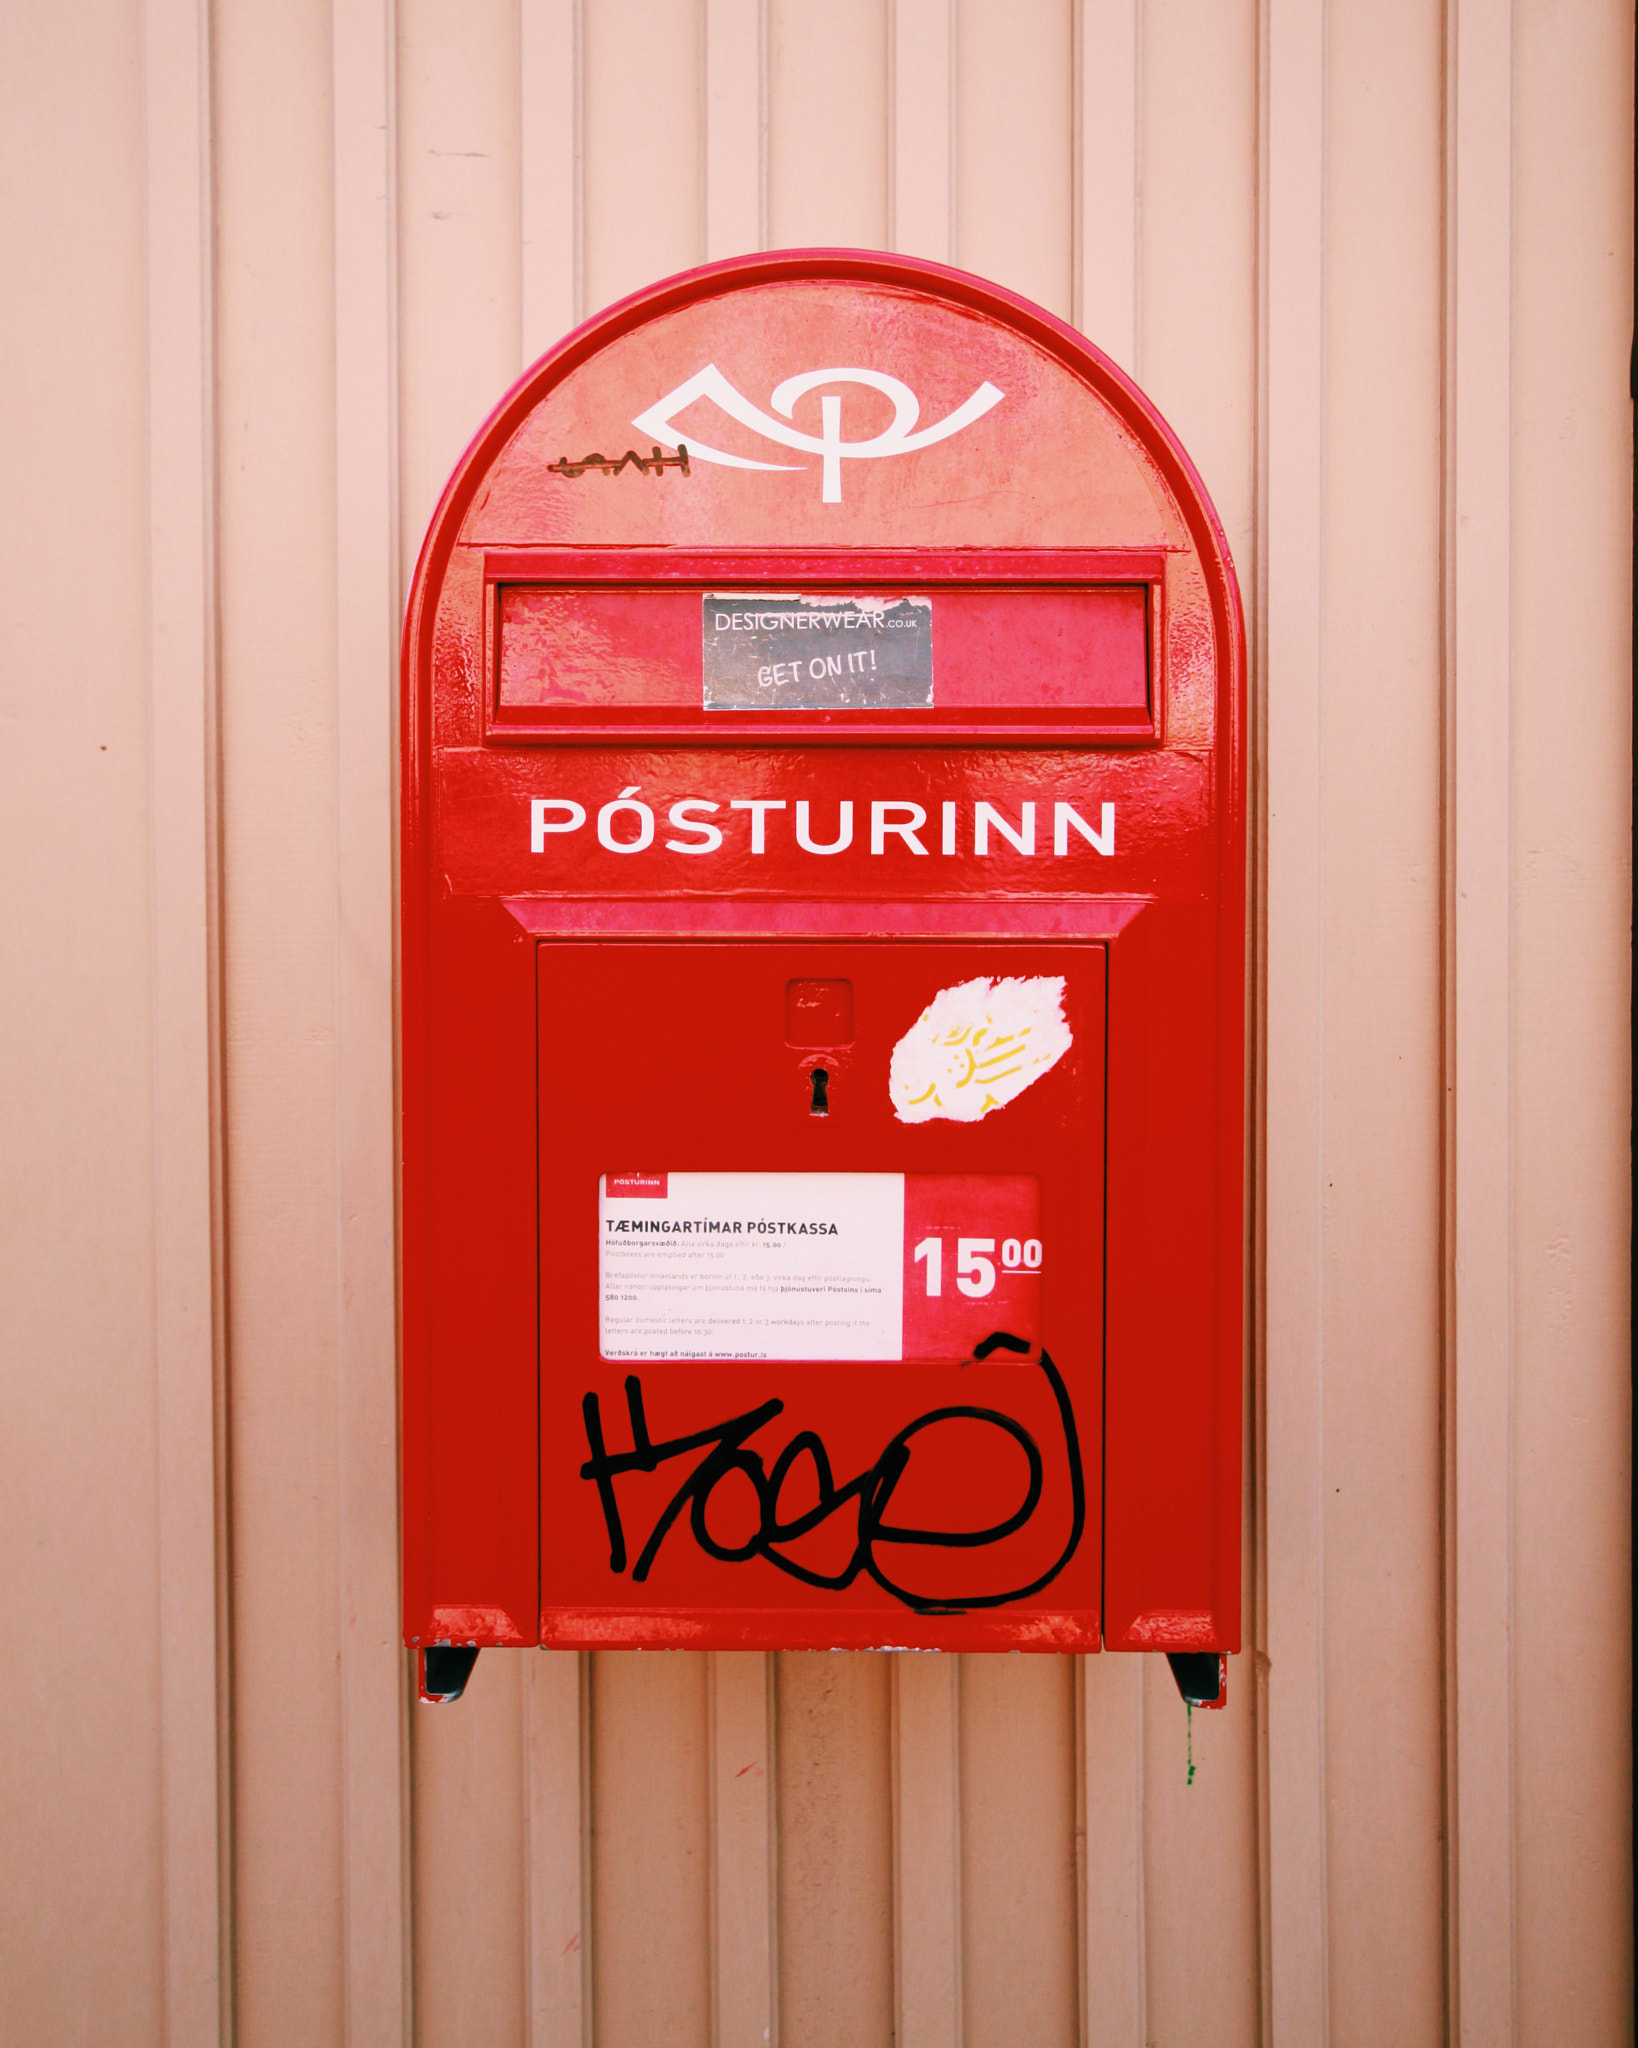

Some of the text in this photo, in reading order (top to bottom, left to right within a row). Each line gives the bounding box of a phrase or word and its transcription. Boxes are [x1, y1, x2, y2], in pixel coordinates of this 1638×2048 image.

[715, 611, 917, 630] DESIGNERWEAR.CO.UK
[758, 650, 876, 687] GET ON IT!
[530, 786, 1115, 855] PÓSTURINN
[606, 1218, 838, 1235] TÆMINGARTÍMAR PÓSTKASSA
